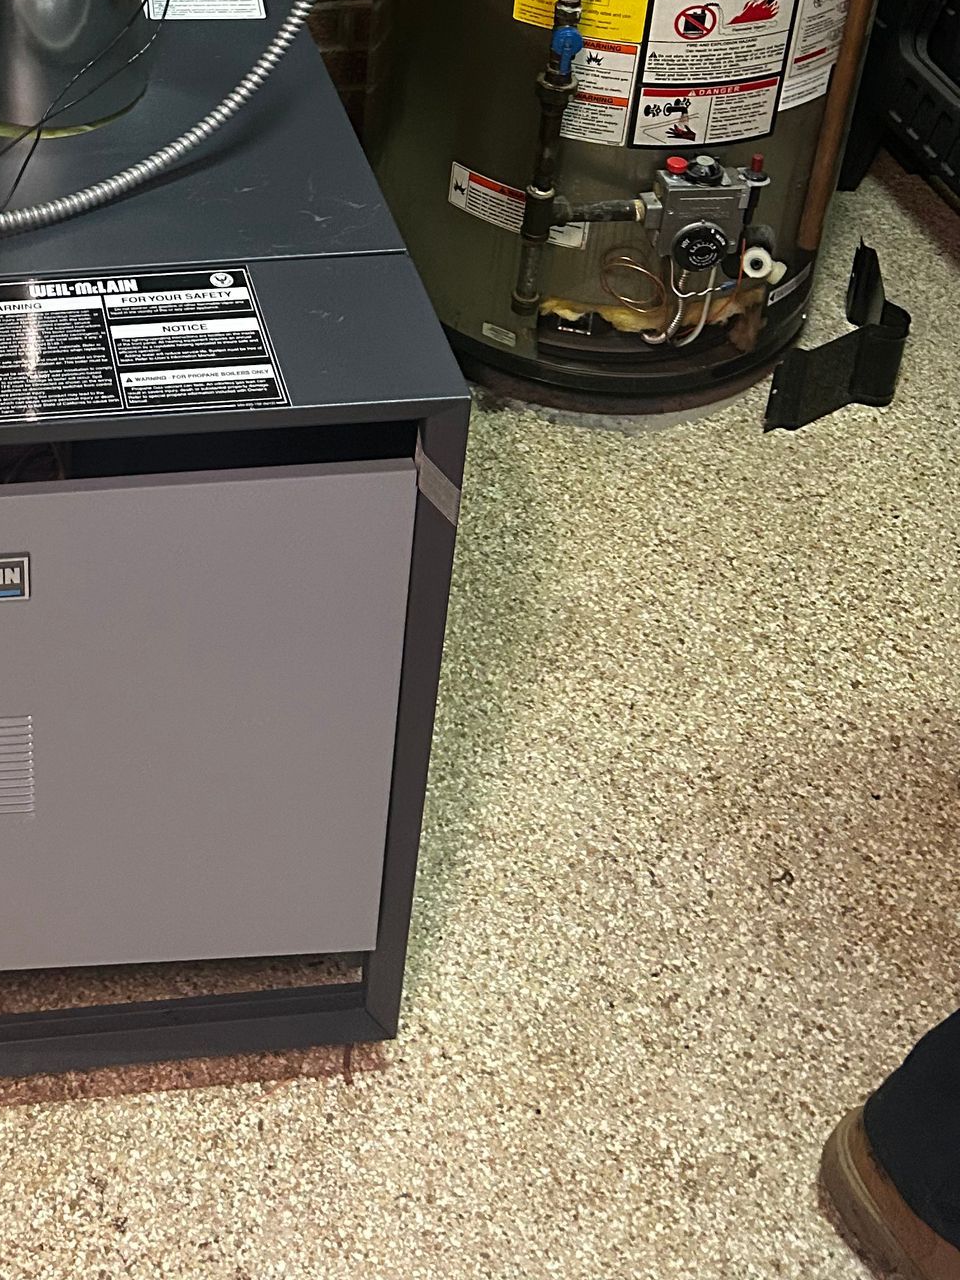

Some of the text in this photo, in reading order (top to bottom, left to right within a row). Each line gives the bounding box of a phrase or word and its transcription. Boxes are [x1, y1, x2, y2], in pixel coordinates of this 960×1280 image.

[699, 86, 740, 96] DANGER
[29, 280, 138, 297] WEIL-McLAIN
[121, 291, 232, 304] FOR YOUR SAFETY
[162, 323, 208, 333] NOTICE
